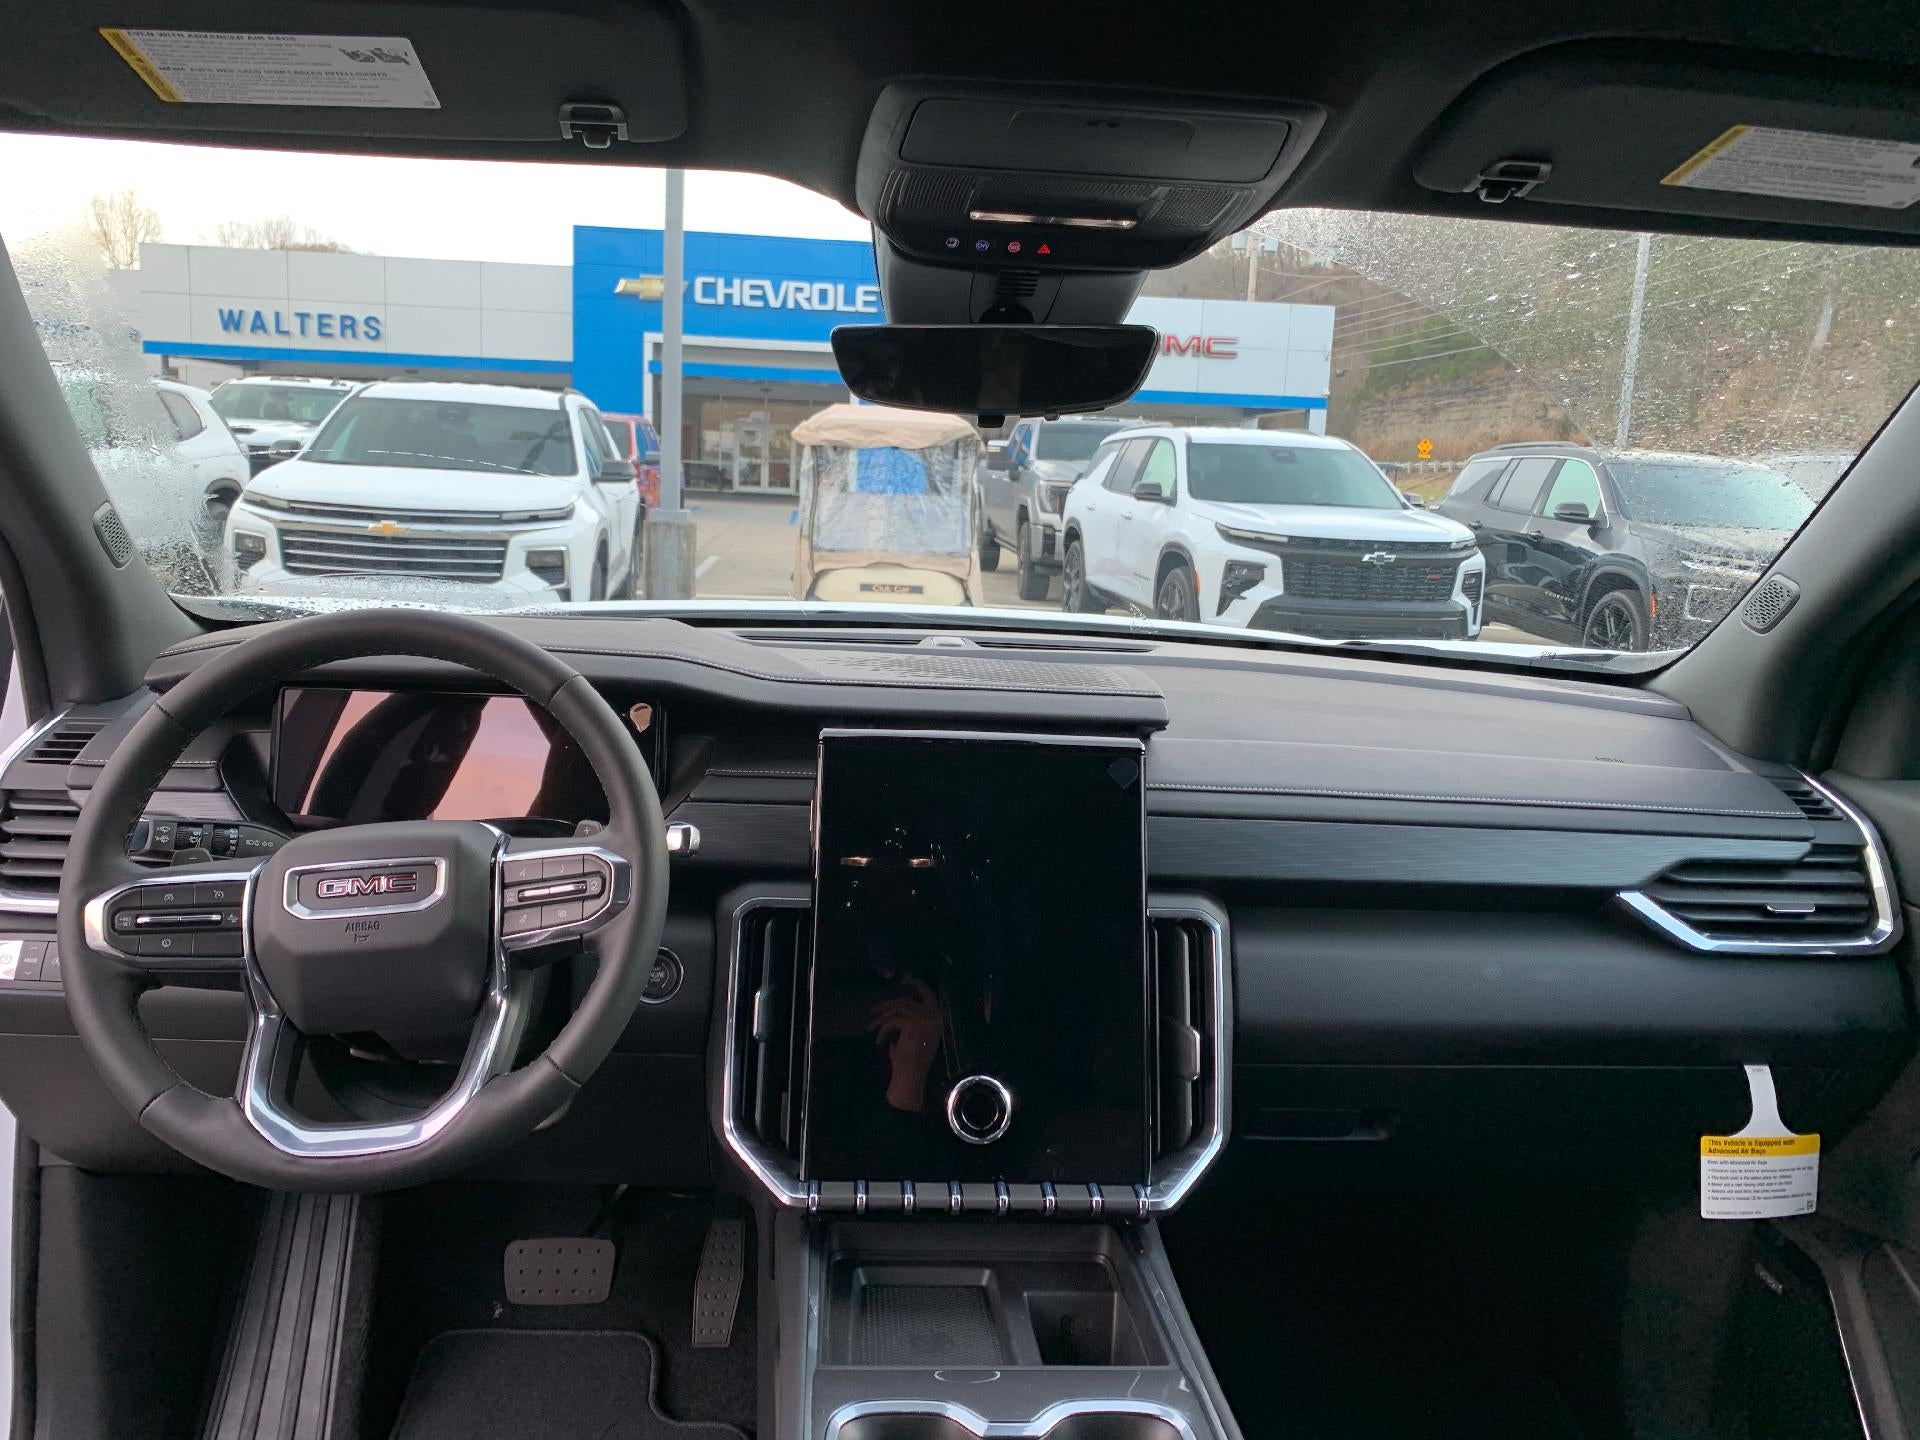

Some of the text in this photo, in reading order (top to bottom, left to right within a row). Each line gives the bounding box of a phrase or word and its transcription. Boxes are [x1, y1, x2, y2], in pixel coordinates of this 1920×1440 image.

[694, 276, 880, 313] CHEVROLE
[218, 308, 381, 340] WALTERS
[1160, 335, 1238, 358] MC
[317, 871, 417, 898] GMC
[345, 921, 379, 933] AIRBAG
[1751, 1147, 1766, 1155] Bags
[1754, 1139, 1782, 1148] Equipped
